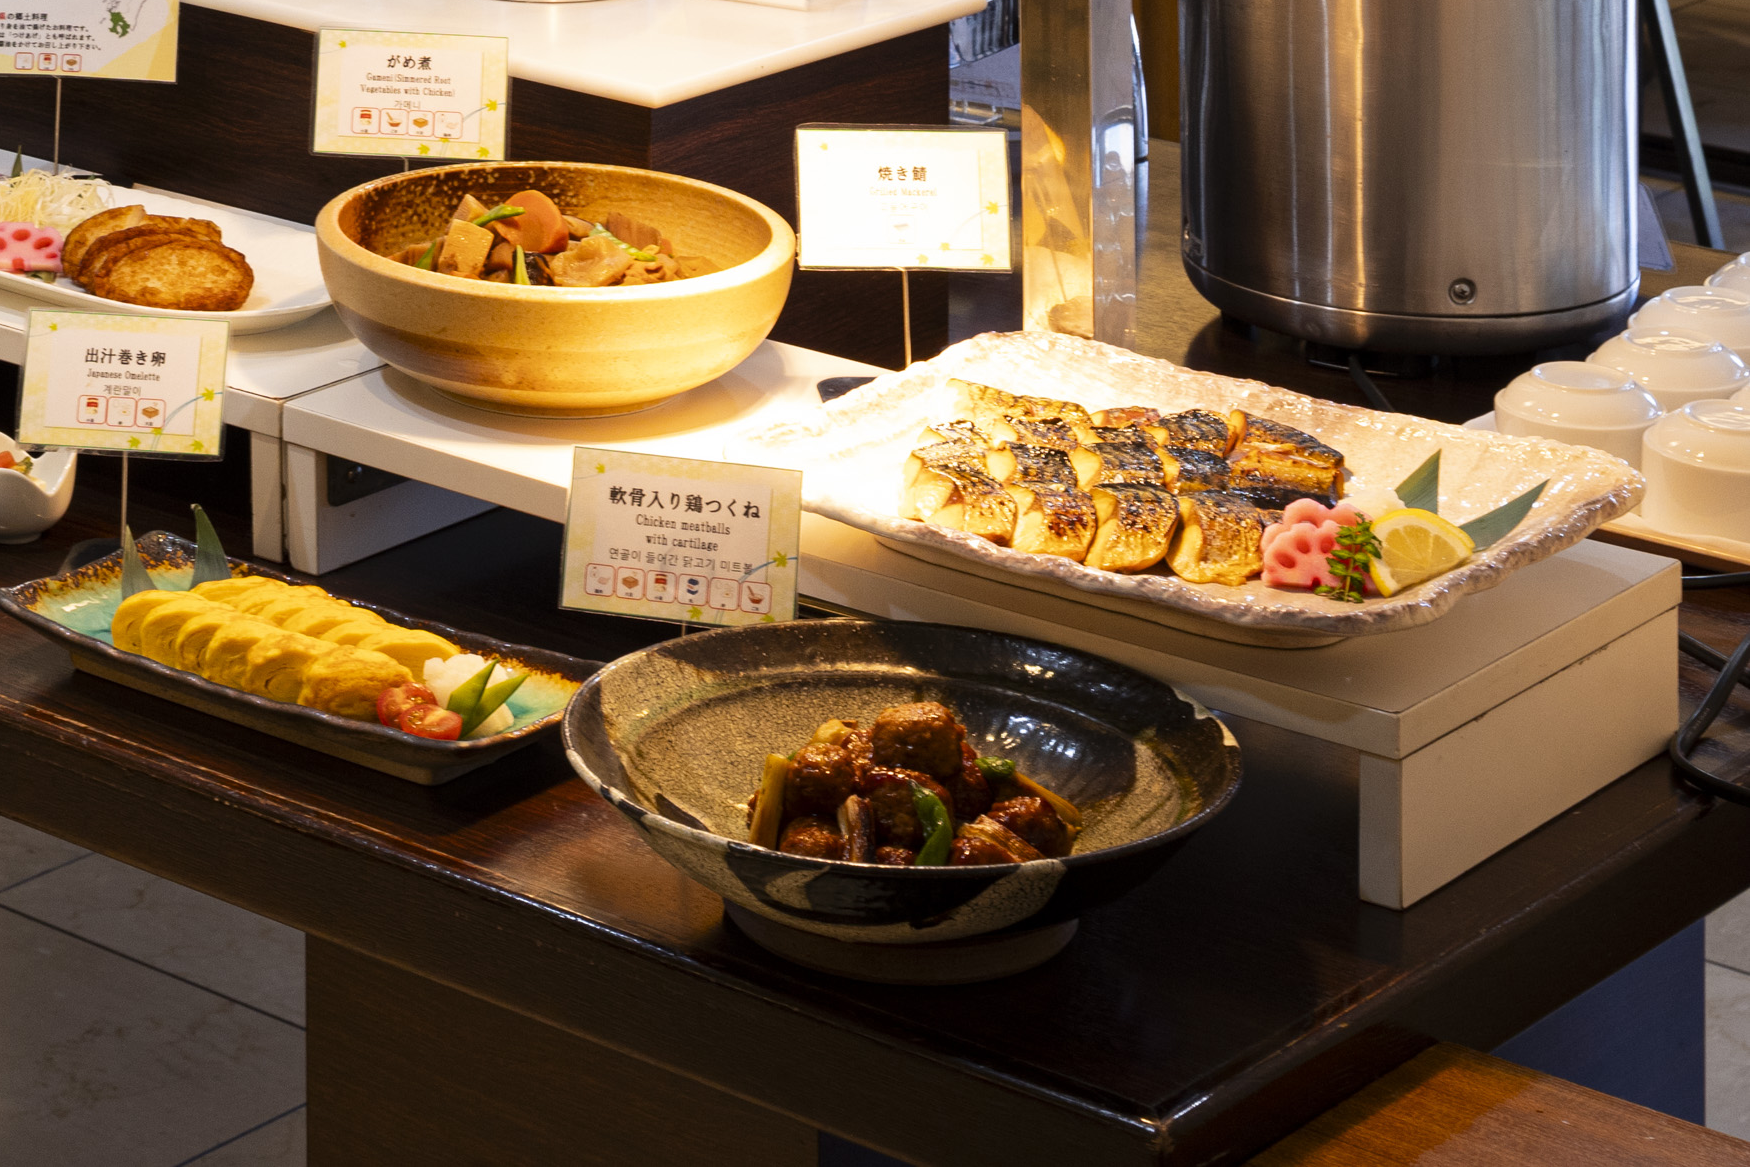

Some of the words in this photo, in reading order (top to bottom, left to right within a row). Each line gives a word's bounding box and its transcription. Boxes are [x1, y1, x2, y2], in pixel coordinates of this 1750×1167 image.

[387, 55, 432, 71] がめ煮
[434, 76, 451, 85] Root
[360, 84, 401, 95] Vegetables
[404, 86, 420, 95] with
[877, 165, 927, 182] 焼き鯖
[85, 348, 166, 367] 出汁巻き卵
[87, 368, 122, 380] Japanese
[125, 370, 160, 381] Omelette
[102, 384, 143, 396] 계란말이
[609, 486, 761, 519] 軟骨入り鶏つくね
[636, 514, 677, 530] Chicken
[681, 520, 731, 535] meatballs
[645, 535, 668, 548] with
[672, 536, 719, 552] cartilage
[609, 547, 641, 562] 연골이
[645, 552, 679, 567] 들어간
[683, 555, 716, 571] 닭고기
